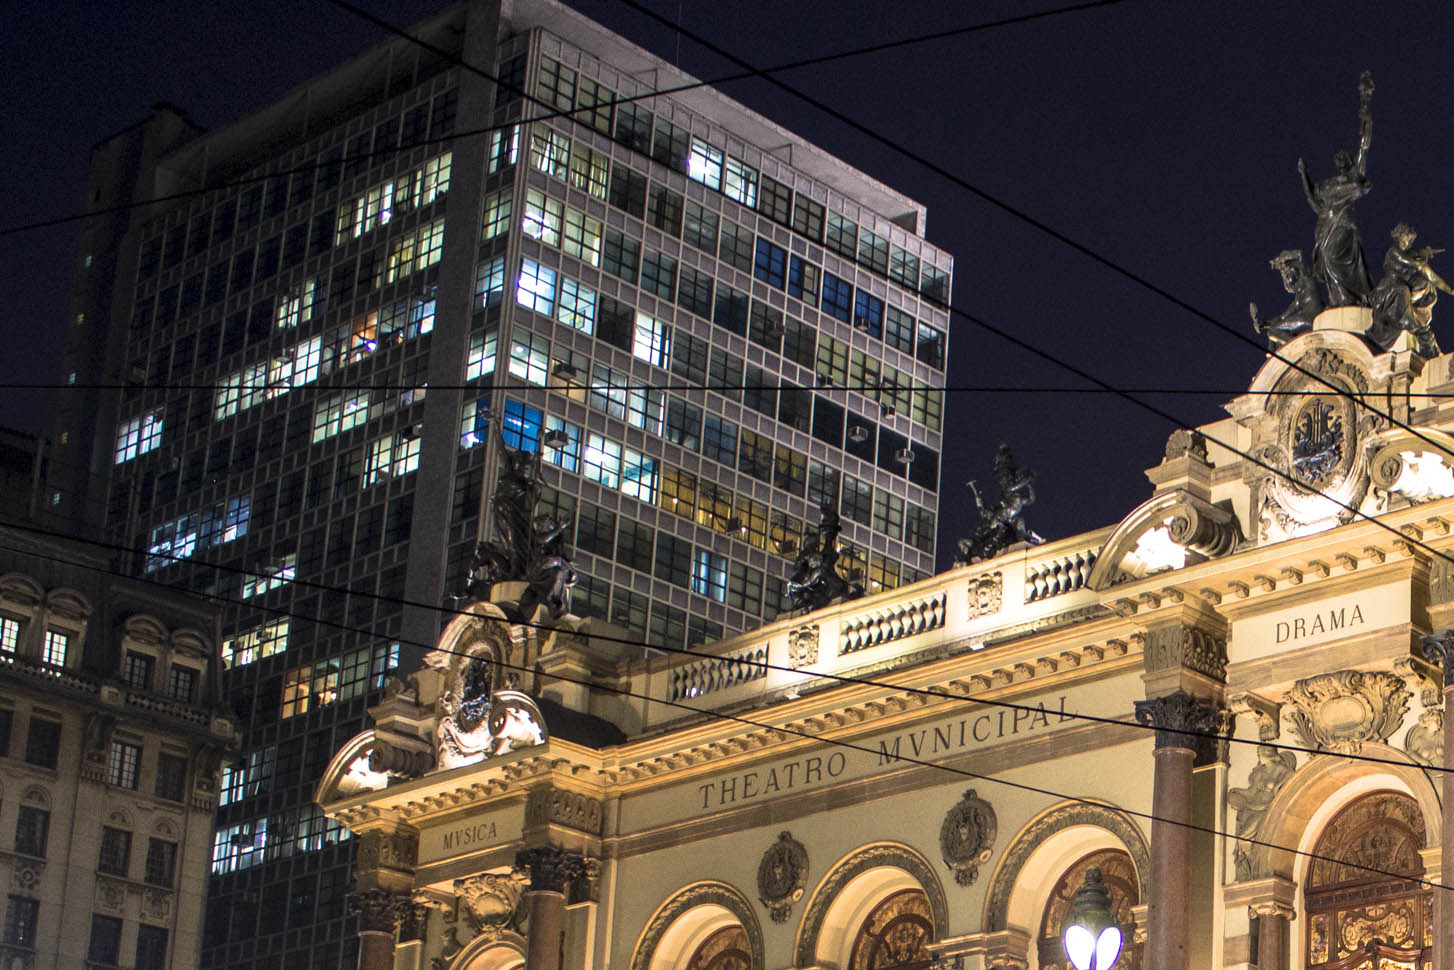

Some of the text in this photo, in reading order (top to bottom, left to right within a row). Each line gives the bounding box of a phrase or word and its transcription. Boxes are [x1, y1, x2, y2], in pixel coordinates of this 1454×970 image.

[1276, 604, 1364, 643] DRAMA
[699, 696, 1079, 808] THEATRO MVNICIPAL
[443, 822, 496, 850] MVSICA
